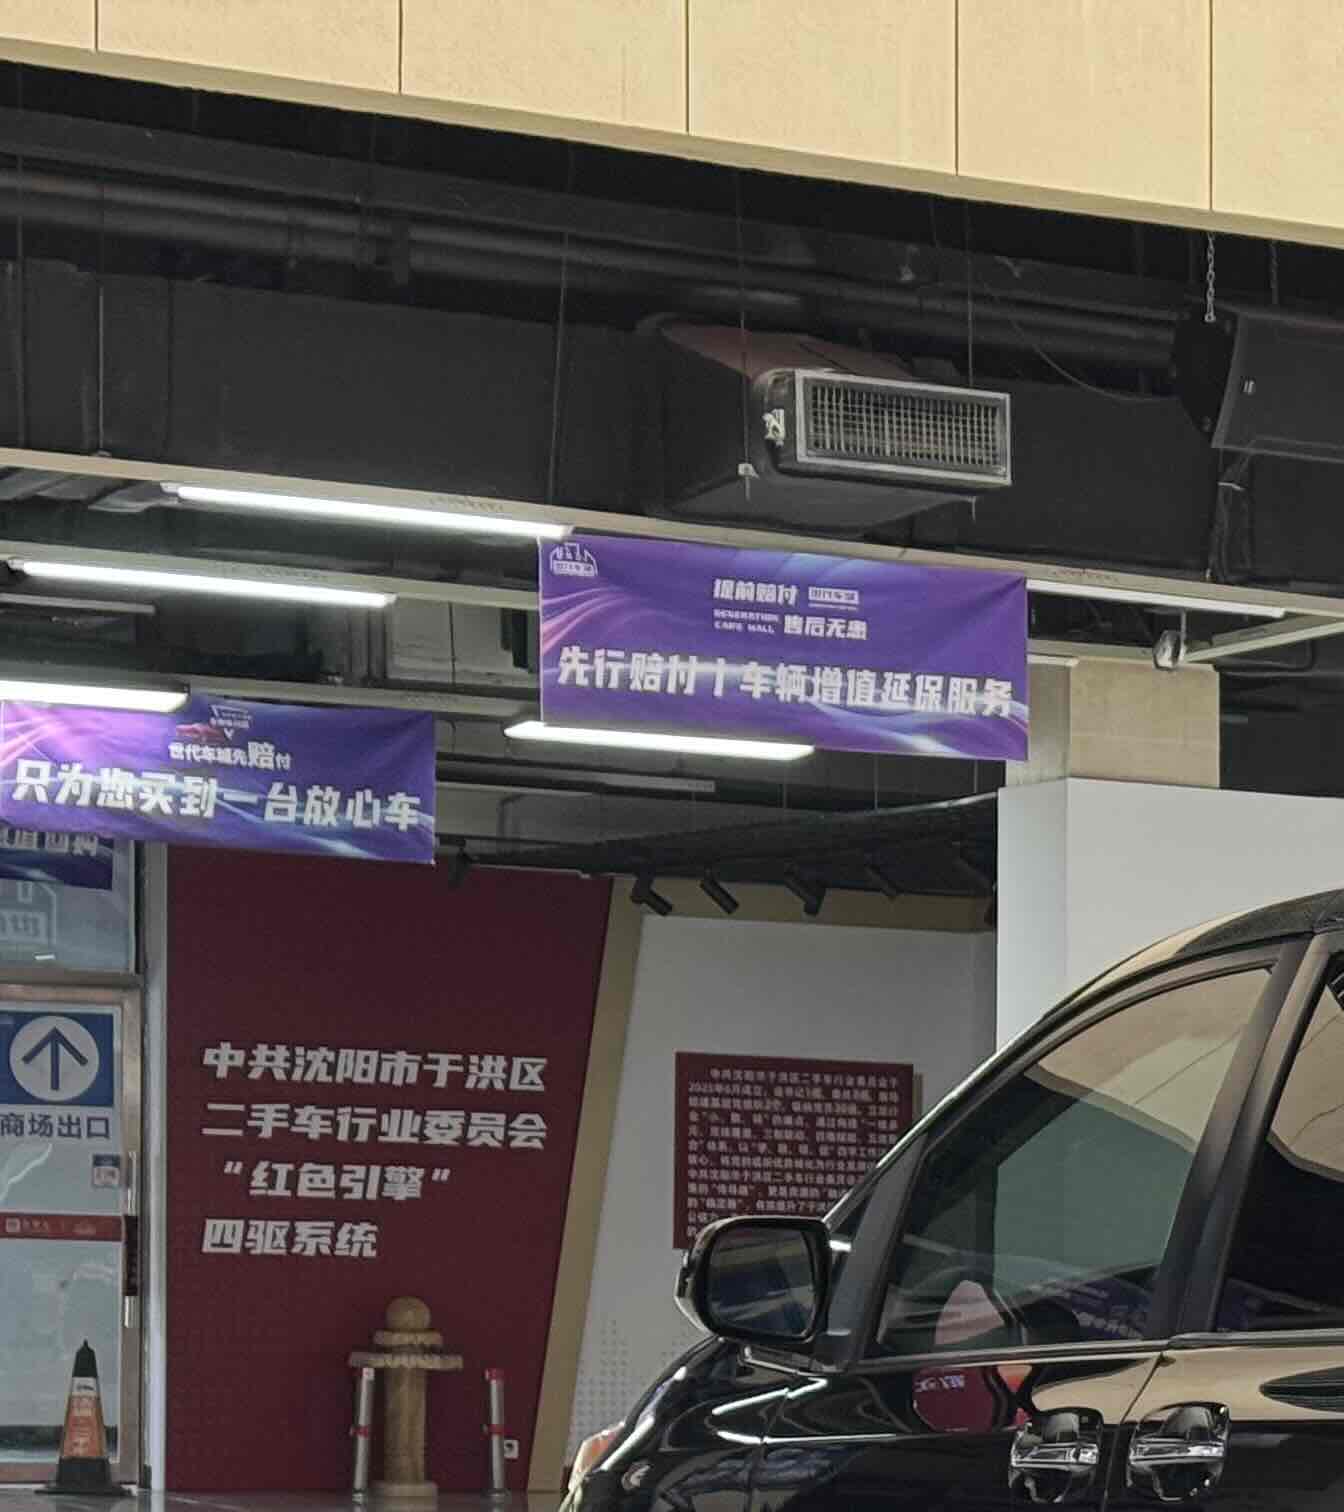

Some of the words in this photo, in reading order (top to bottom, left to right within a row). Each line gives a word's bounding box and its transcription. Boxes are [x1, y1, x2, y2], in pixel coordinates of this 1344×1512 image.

[713, 578, 797, 606] 提前赔付
[12, 758, 422, 832] 只为您买到一台放心车
[201, 1042, 548, 1091] 中共沈阳市于洪区
[0, 1112, 110, 1140] 商场出口
[201, 1102, 548, 1149] 二手车行业委员会
[202, 1218, 378, 1258] 四驱系统
